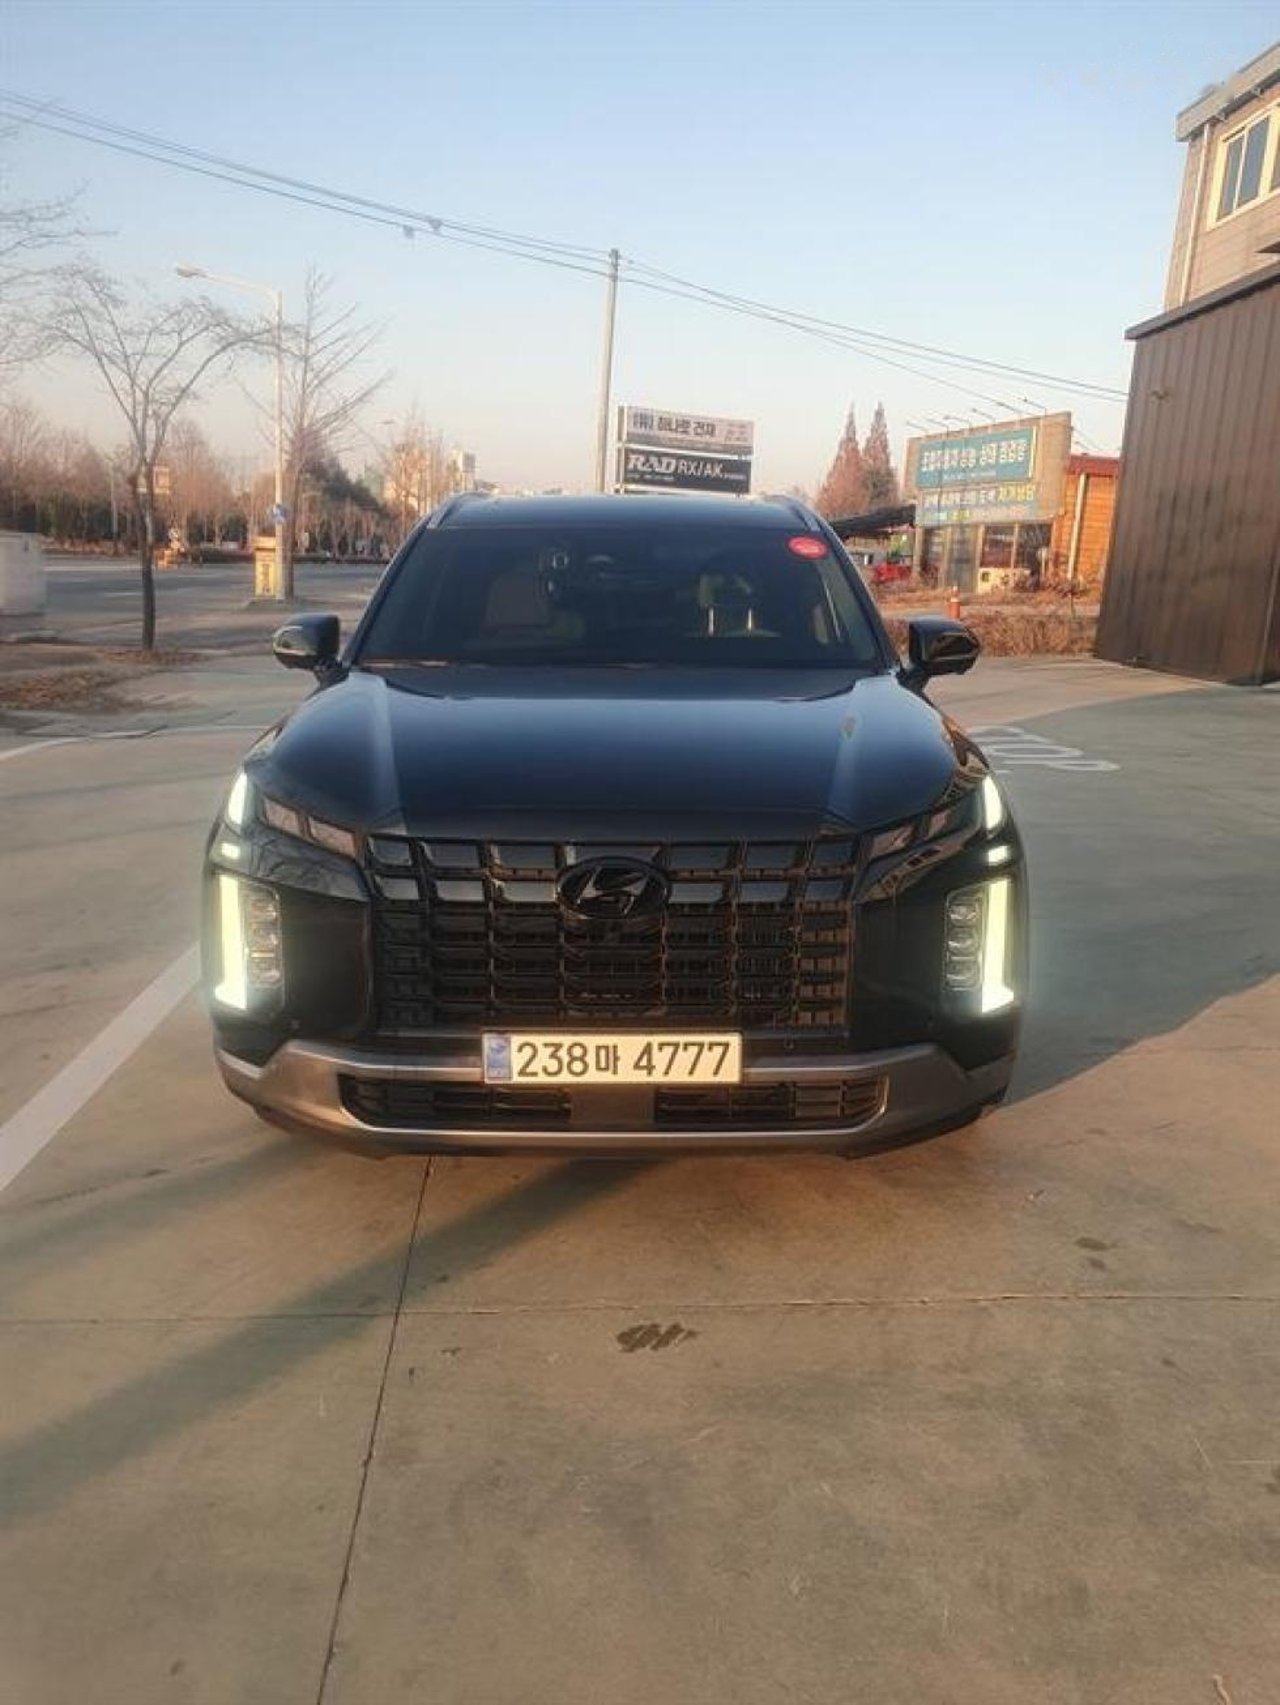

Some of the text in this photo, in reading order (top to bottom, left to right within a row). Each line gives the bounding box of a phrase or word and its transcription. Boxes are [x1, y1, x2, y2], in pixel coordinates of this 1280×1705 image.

[627, 454, 676, 473] RAD
[516, 1041, 730, 1077] 238마 4777
